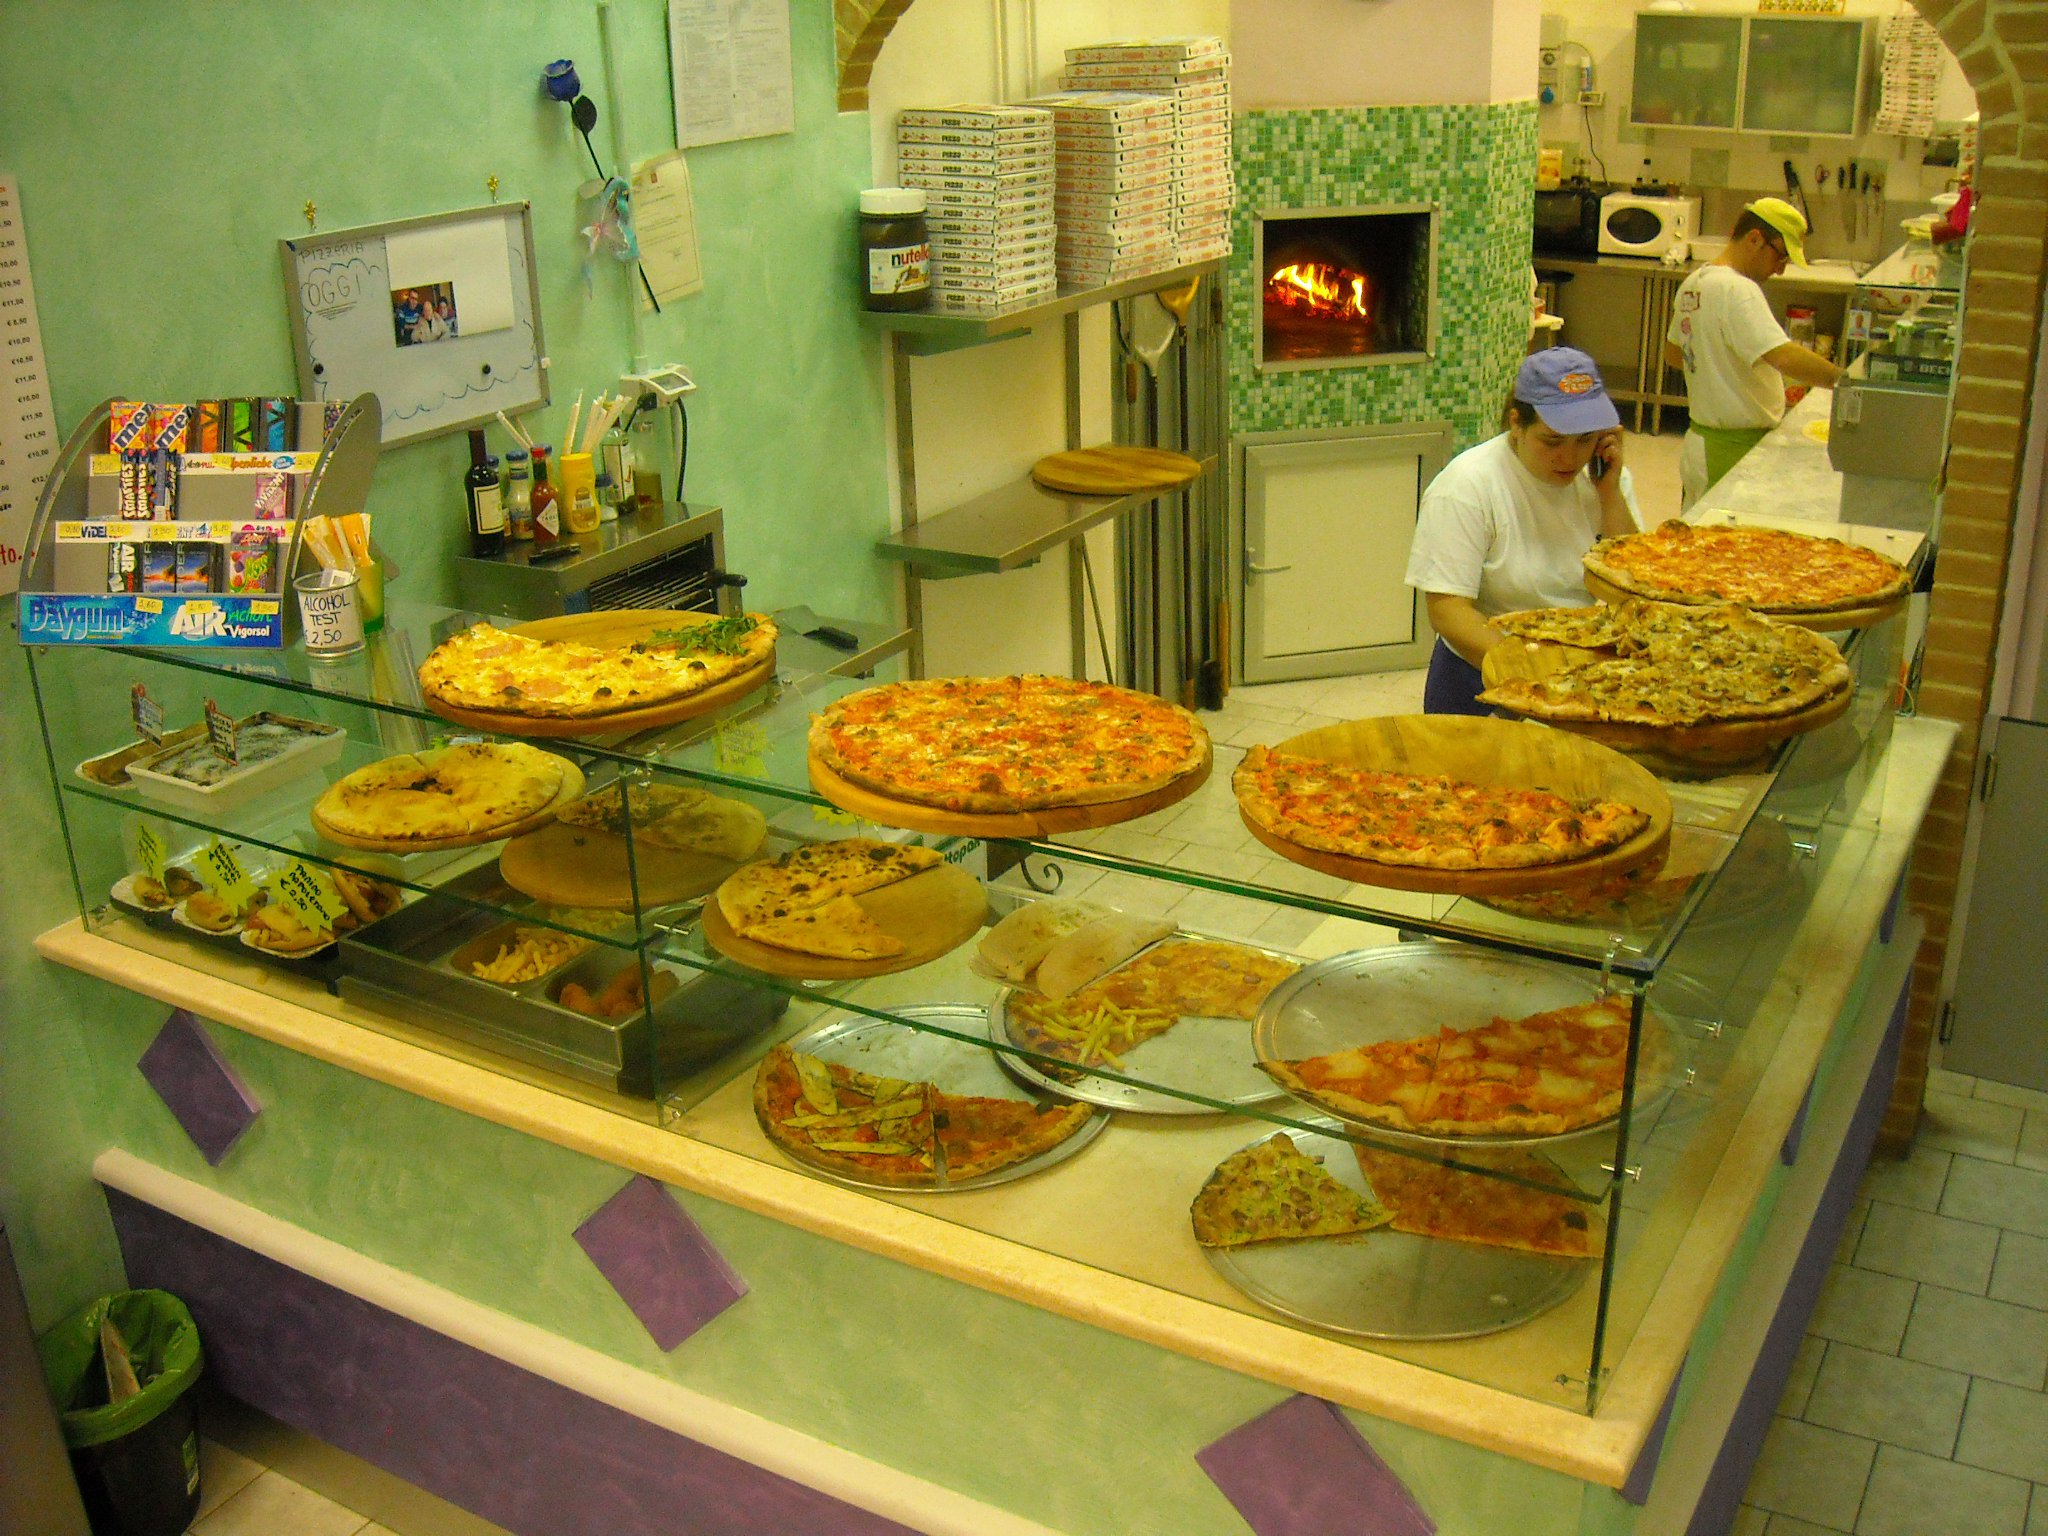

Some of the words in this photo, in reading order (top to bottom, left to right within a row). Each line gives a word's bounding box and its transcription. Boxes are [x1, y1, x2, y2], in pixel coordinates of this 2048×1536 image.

[308, 274, 361, 307] OGGI
[304, 593, 350, 612] ALCOHOL
[310, 611, 341, 626] TEST
[223, 624, 270, 639] Vigorsol
